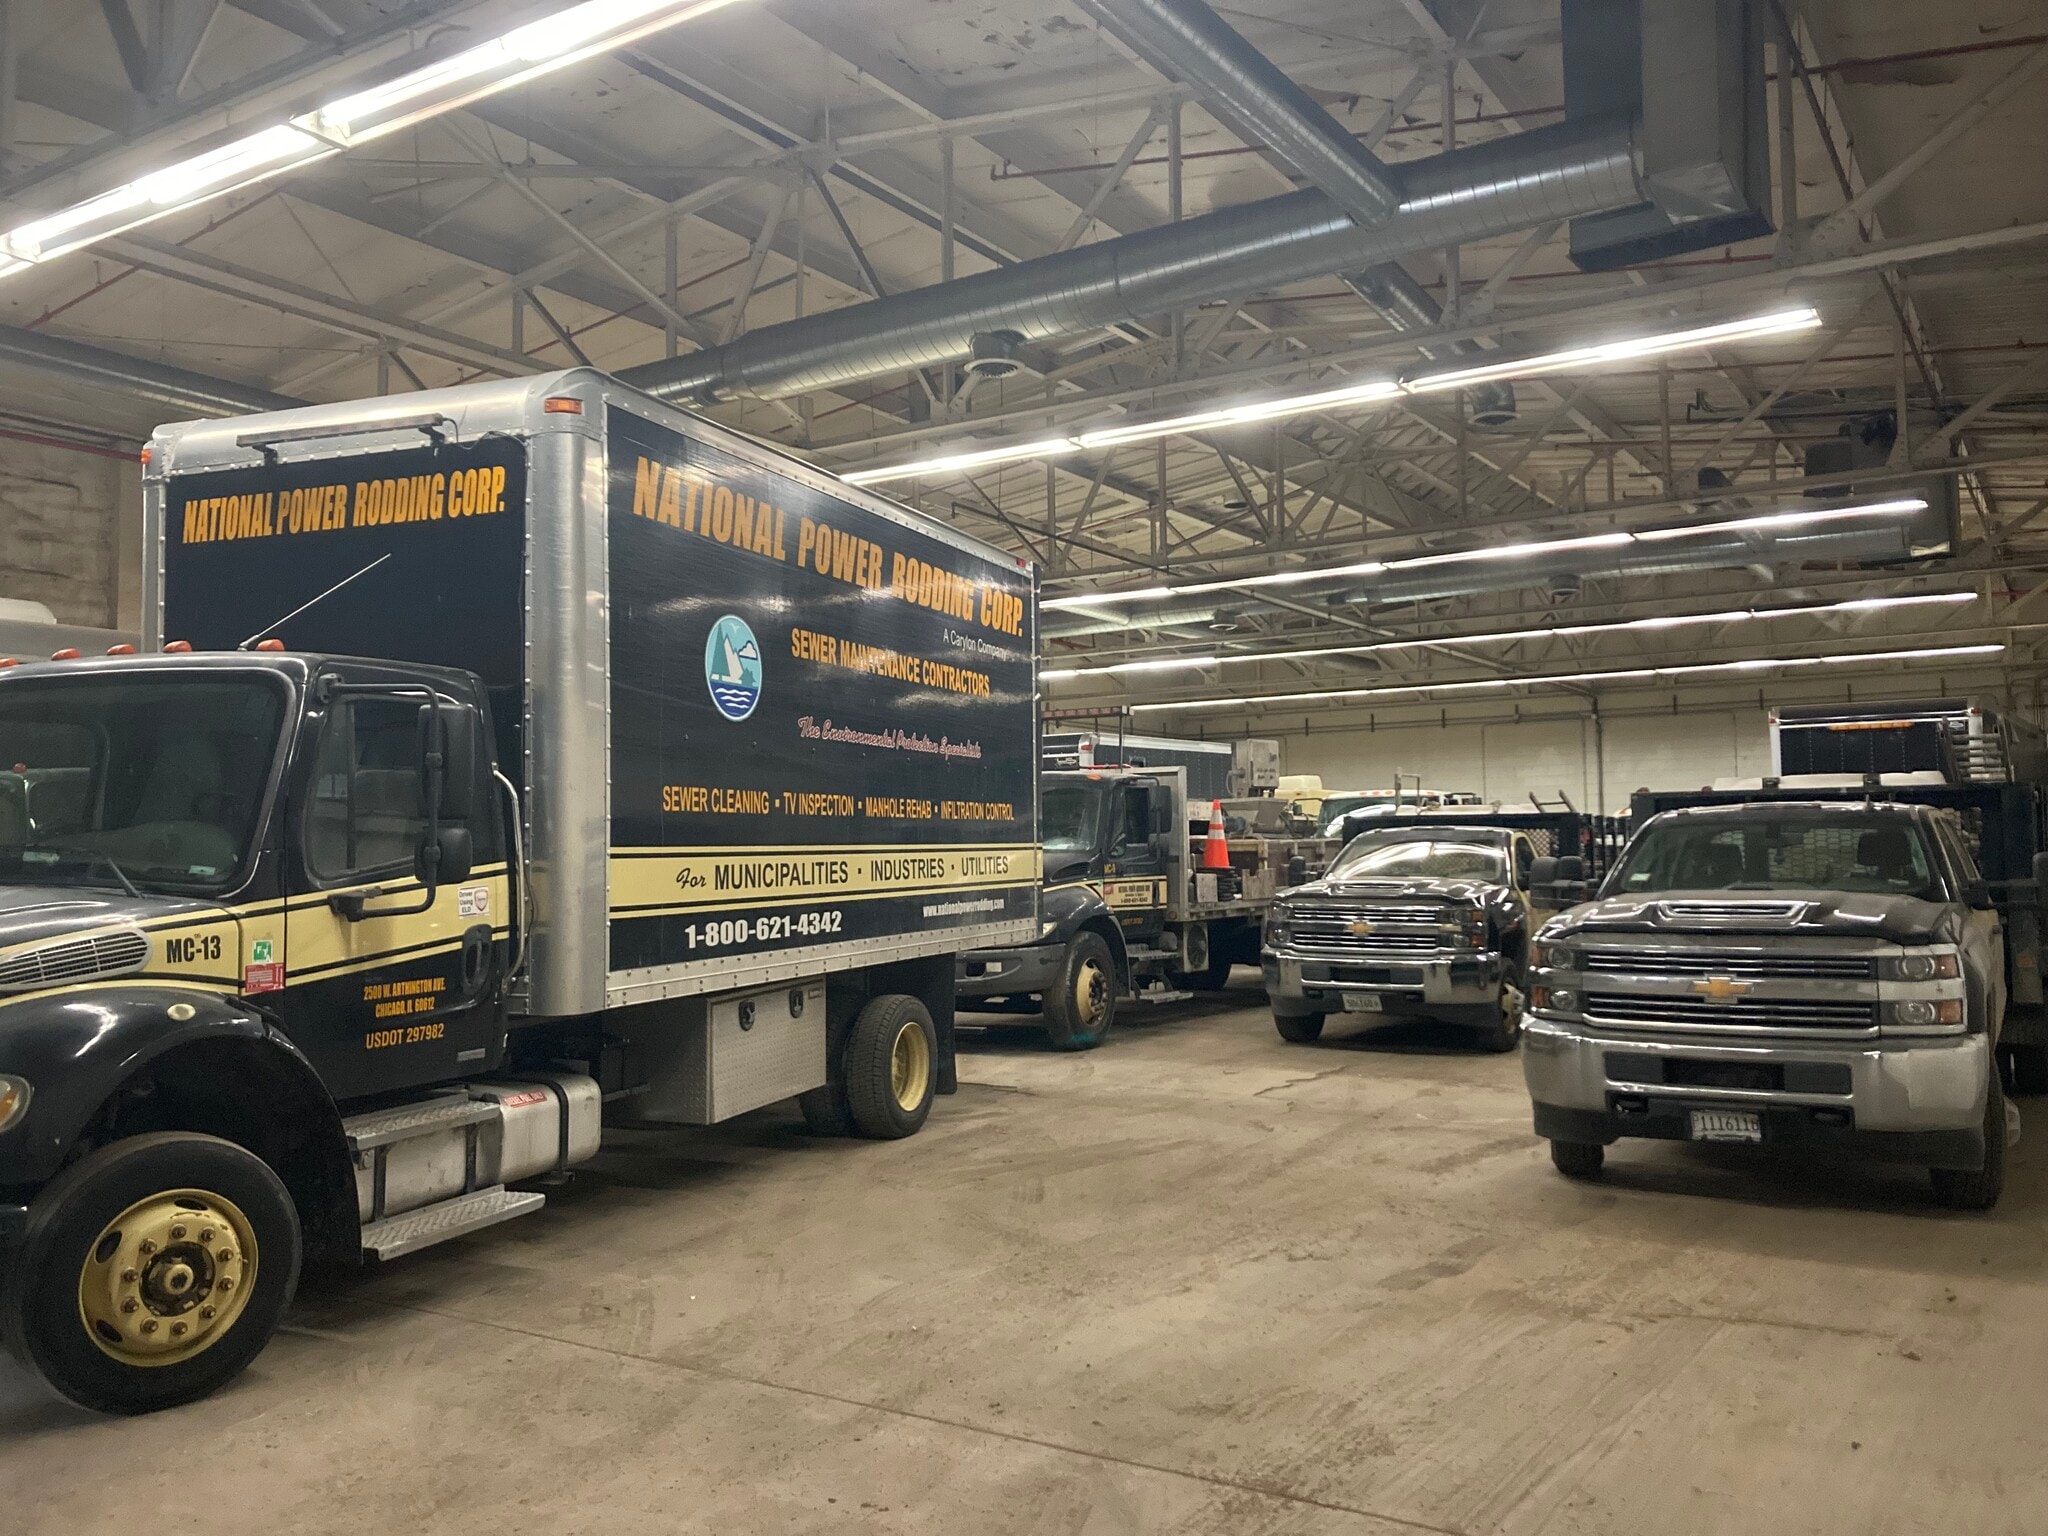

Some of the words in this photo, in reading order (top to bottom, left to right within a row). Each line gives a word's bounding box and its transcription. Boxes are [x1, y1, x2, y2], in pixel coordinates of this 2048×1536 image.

[182, 492, 276, 544] NATIONAL
[276, 484, 348, 535] POWER
[353, 471, 445, 527] RODDING
[448, 466, 506, 518] CORP.
[633, 455, 786, 561] NATIONAL
[797, 517, 882, 591] POWER
[891, 552, 975, 621] RODDING
[979, 587, 1023, 637] CORP.
[791, 627, 839, 664] SEWER
[839, 640, 921, 684] MAINTENANCE
[922, 660, 990, 699] CONTRACTORS
[943, 628, 950, 644] A
[977, 638, 1007, 662] Company
[798, 716, 820, 740] The
[821, 719, 896, 749] Environmental
[896, 729, 938, 754] Protection
[662, 785, 709, 813] SEWER
[711, 788, 770, 815] CLEANING
[783, 791, 797, 815] TV
[798, 793, 855, 818] INSPECTION
[865, 796, 905, 820] MANHOLE
[906, 798, 932, 820] REHAB
[940, 800, 985, 821] INFILTRATION
[985, 801, 1015, 821] CONTROL
[676, 868, 708, 890] For
[714, 860, 849, 891] MUNICIPALITIES
[869, 857, 945, 883] INDUSTRIES
[961, 855, 1009, 877] UTILITIES
[684, 910, 843, 950] 1-800-621-4342
[166, 935, 222, 964] MC-13
[364, 985, 382, 1000] 2500
[383, 982, 391, 998] W.
[433, 977, 447, 991] AVE.
[375, 1000, 406, 1018] CHICAGO,
[407, 999, 413, 1013] IL
[365, 1028, 405, 1050] USDOT
[406, 1022, 445, 1043] 297982
